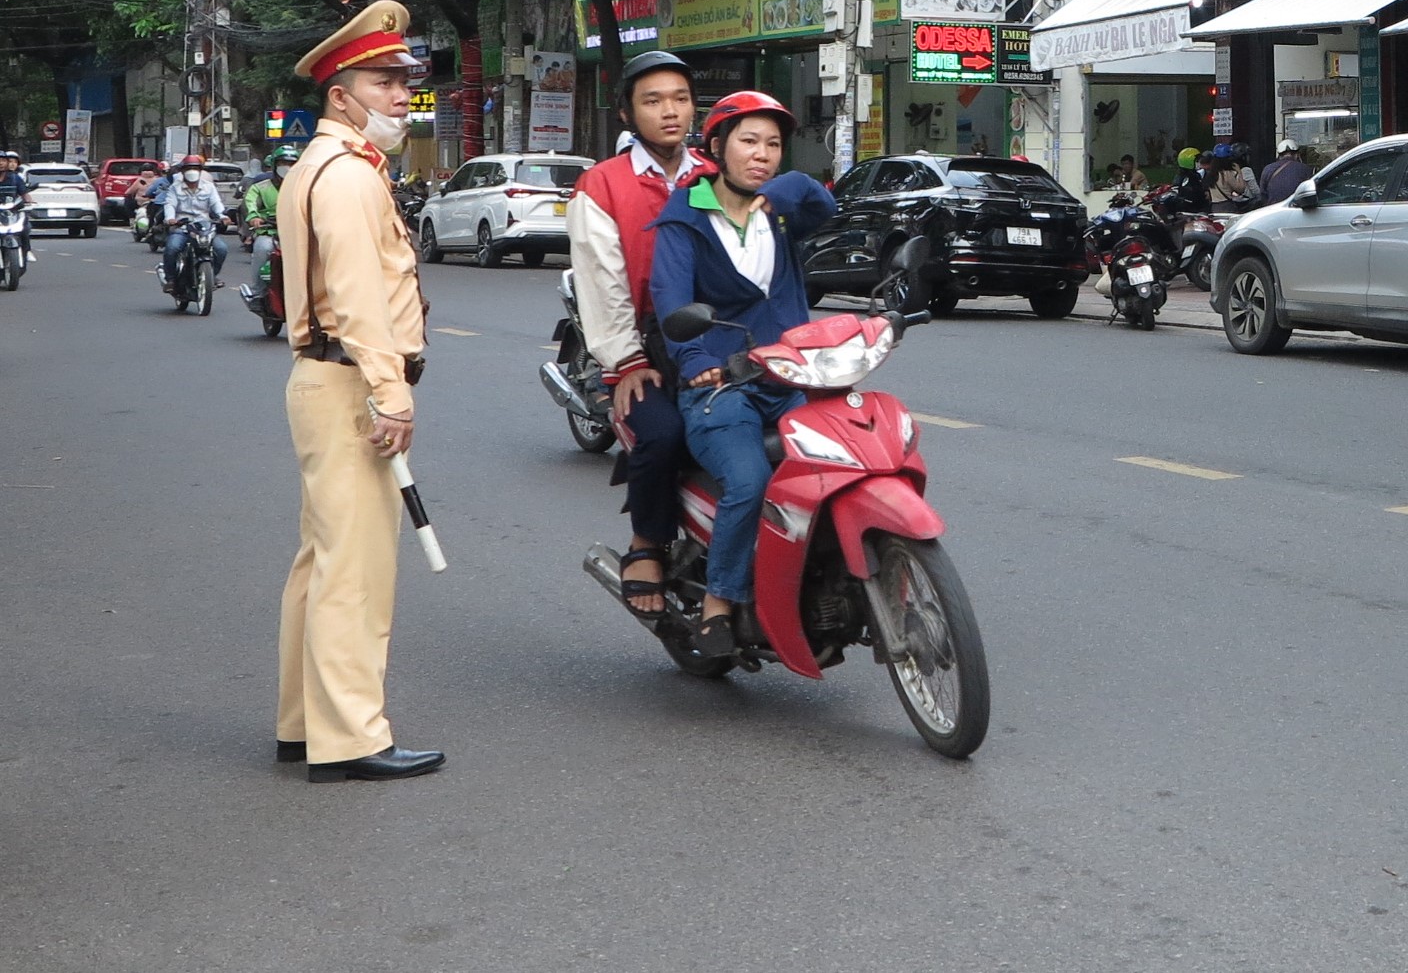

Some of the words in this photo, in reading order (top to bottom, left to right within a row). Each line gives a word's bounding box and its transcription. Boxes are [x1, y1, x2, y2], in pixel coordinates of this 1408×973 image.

[915, 24, 992, 52] ODESSA
[1002, 29, 1029, 40] EMER
[916, 53, 961, 70] HOTEL
